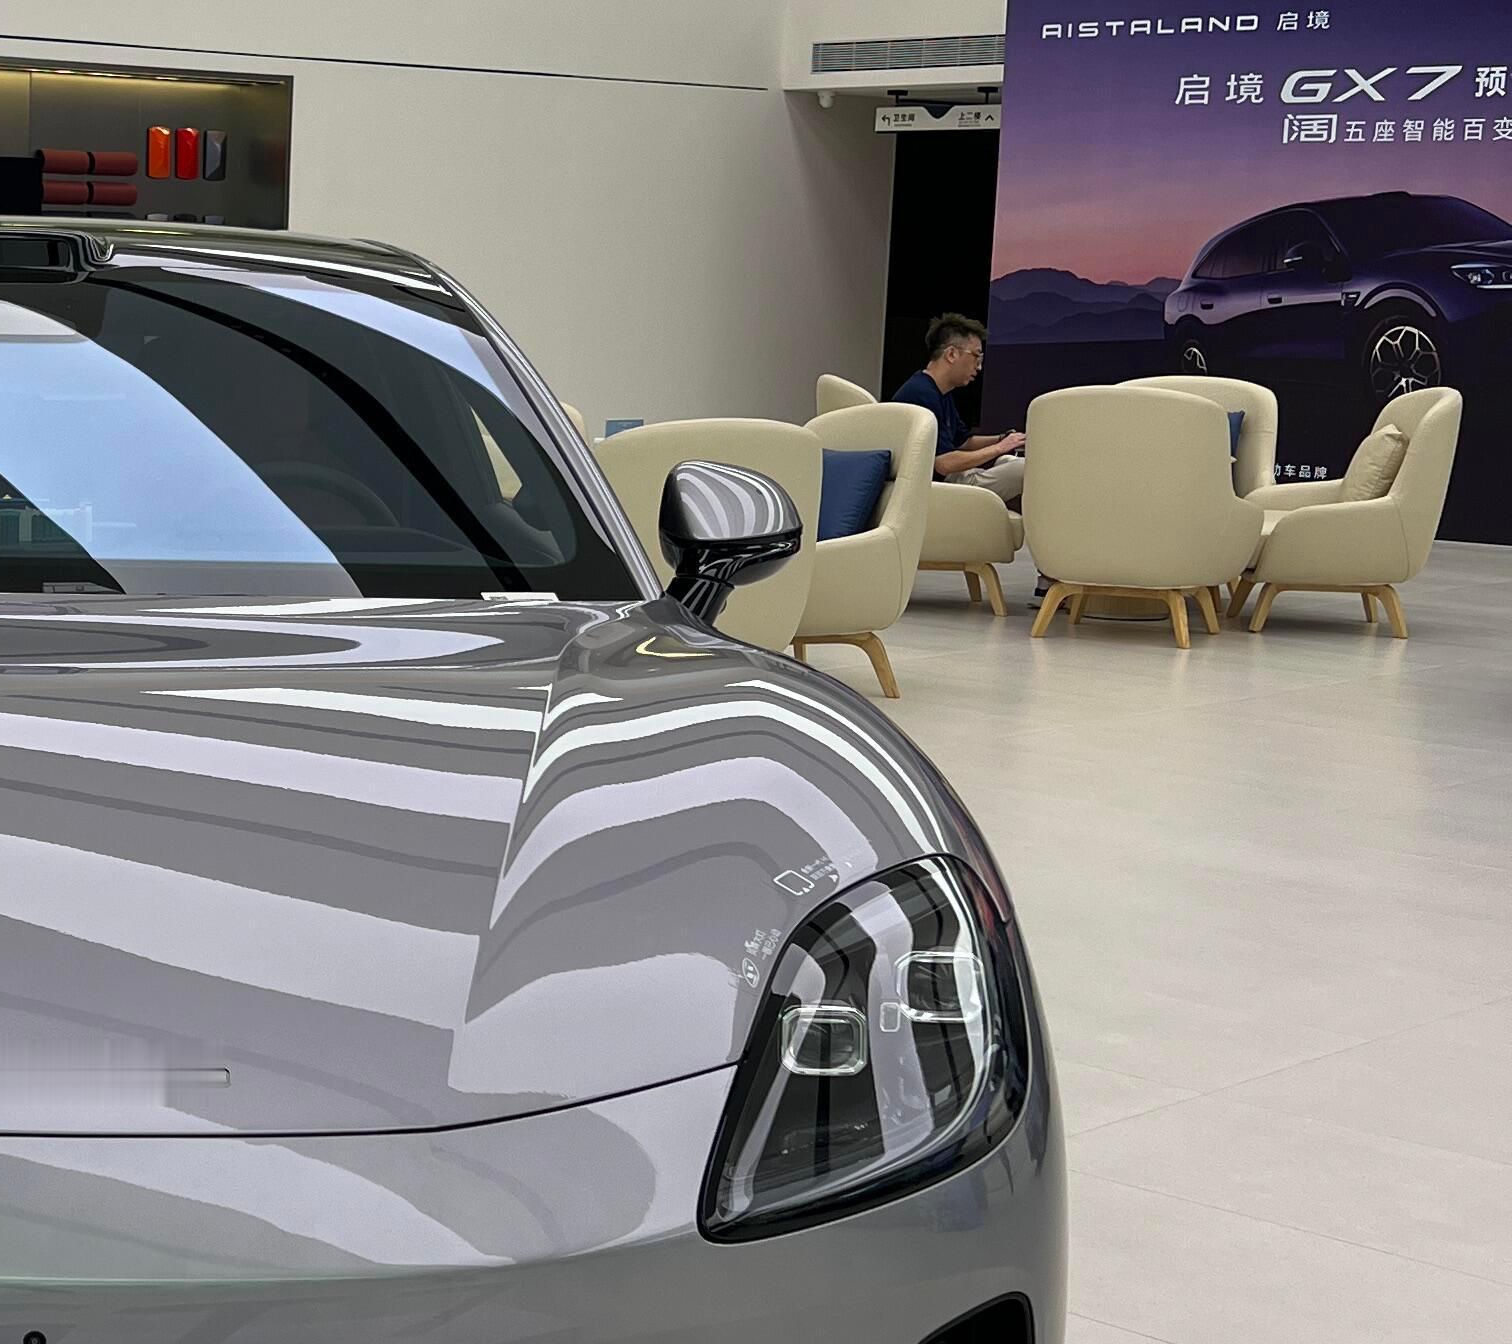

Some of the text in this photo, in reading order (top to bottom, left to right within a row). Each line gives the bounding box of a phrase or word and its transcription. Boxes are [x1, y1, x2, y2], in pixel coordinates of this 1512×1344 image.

[1041, 10, 1331, 39] AISTALAND 启境
[1174, 72, 1265, 105] 启境
